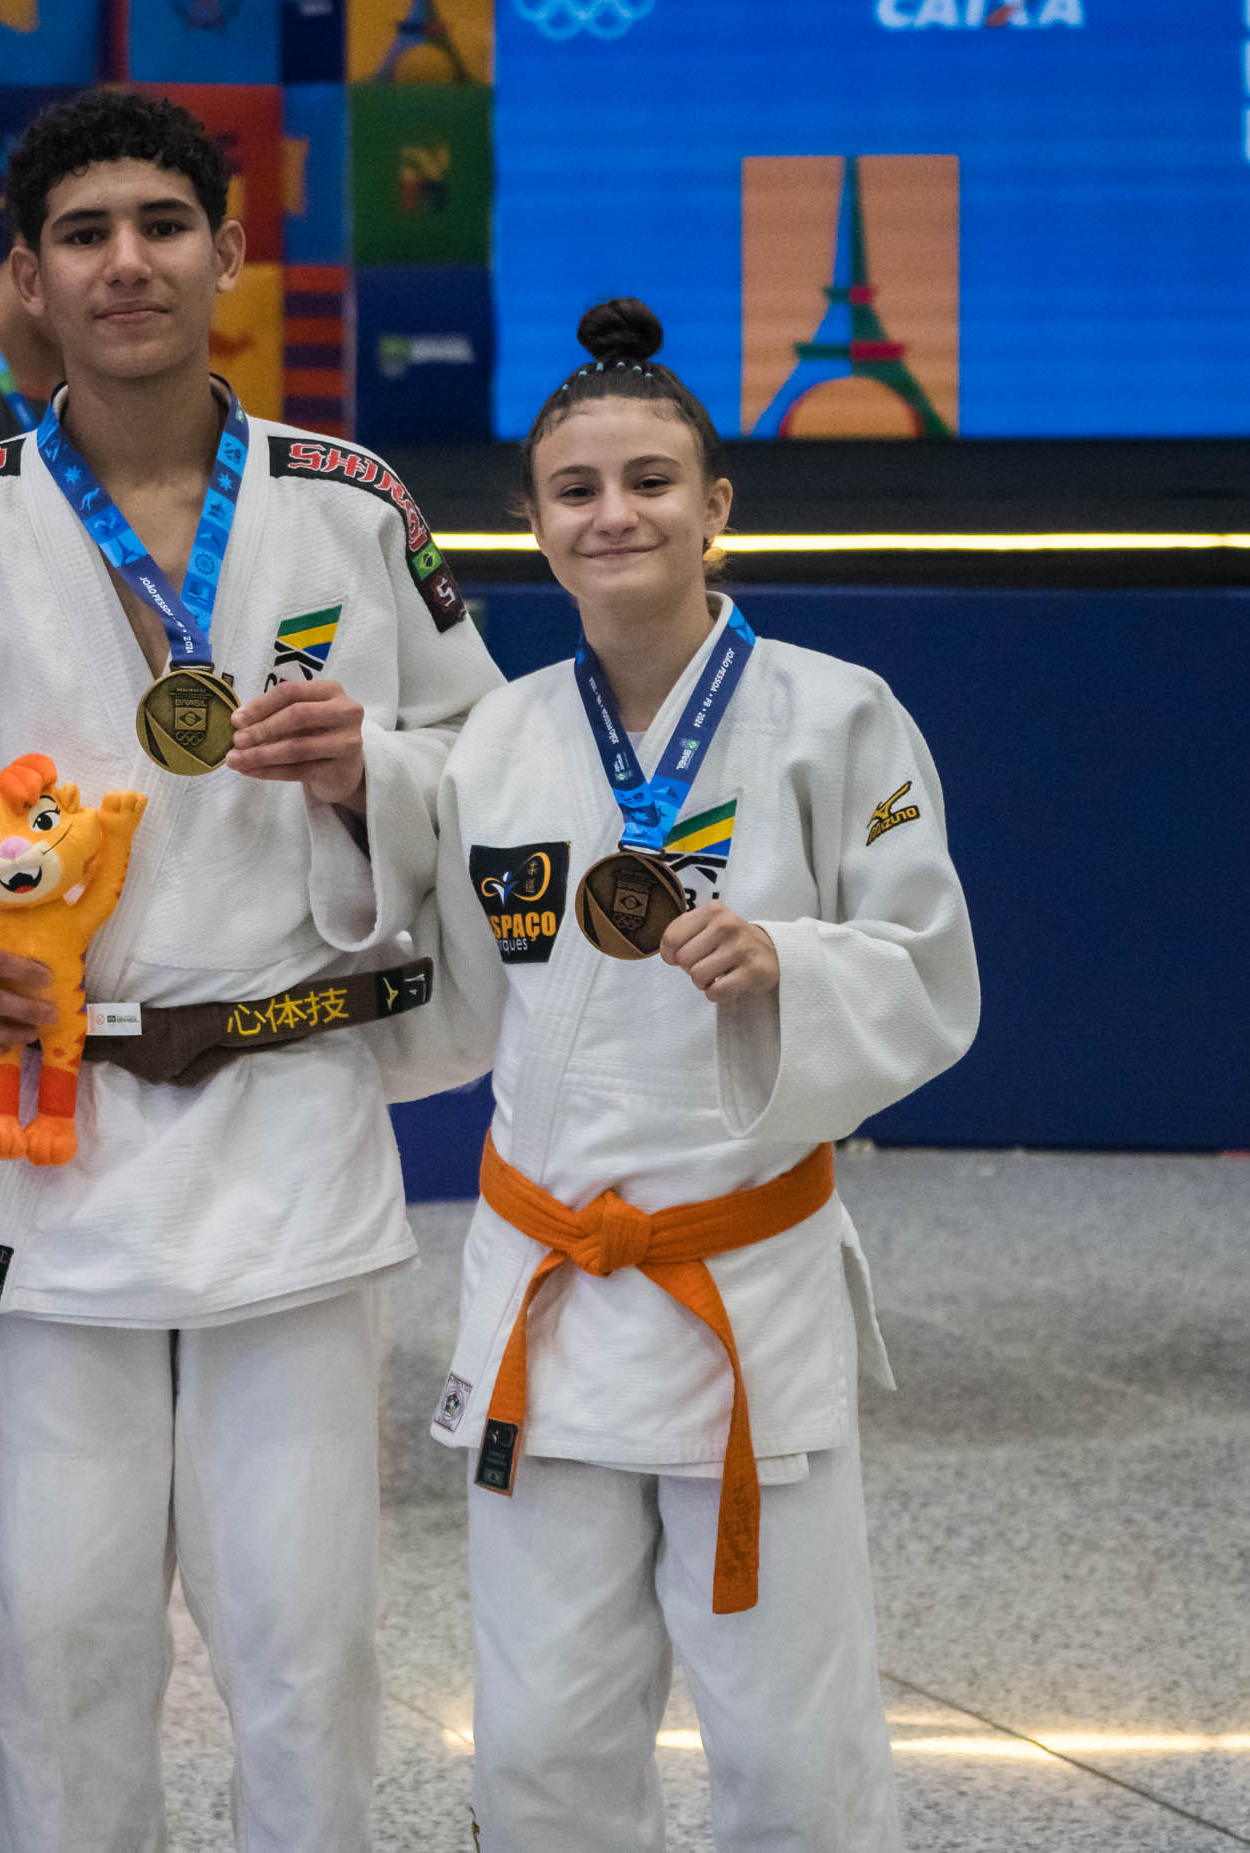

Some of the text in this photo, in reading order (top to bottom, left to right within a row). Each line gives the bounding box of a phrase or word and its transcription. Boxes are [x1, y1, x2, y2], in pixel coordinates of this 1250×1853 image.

[710, 666, 726, 692] PESSOA
[693, 711, 706, 728] 2024
[490, 911, 556, 941] SPAÇO
[227, 987, 349, 1036] 心体技
